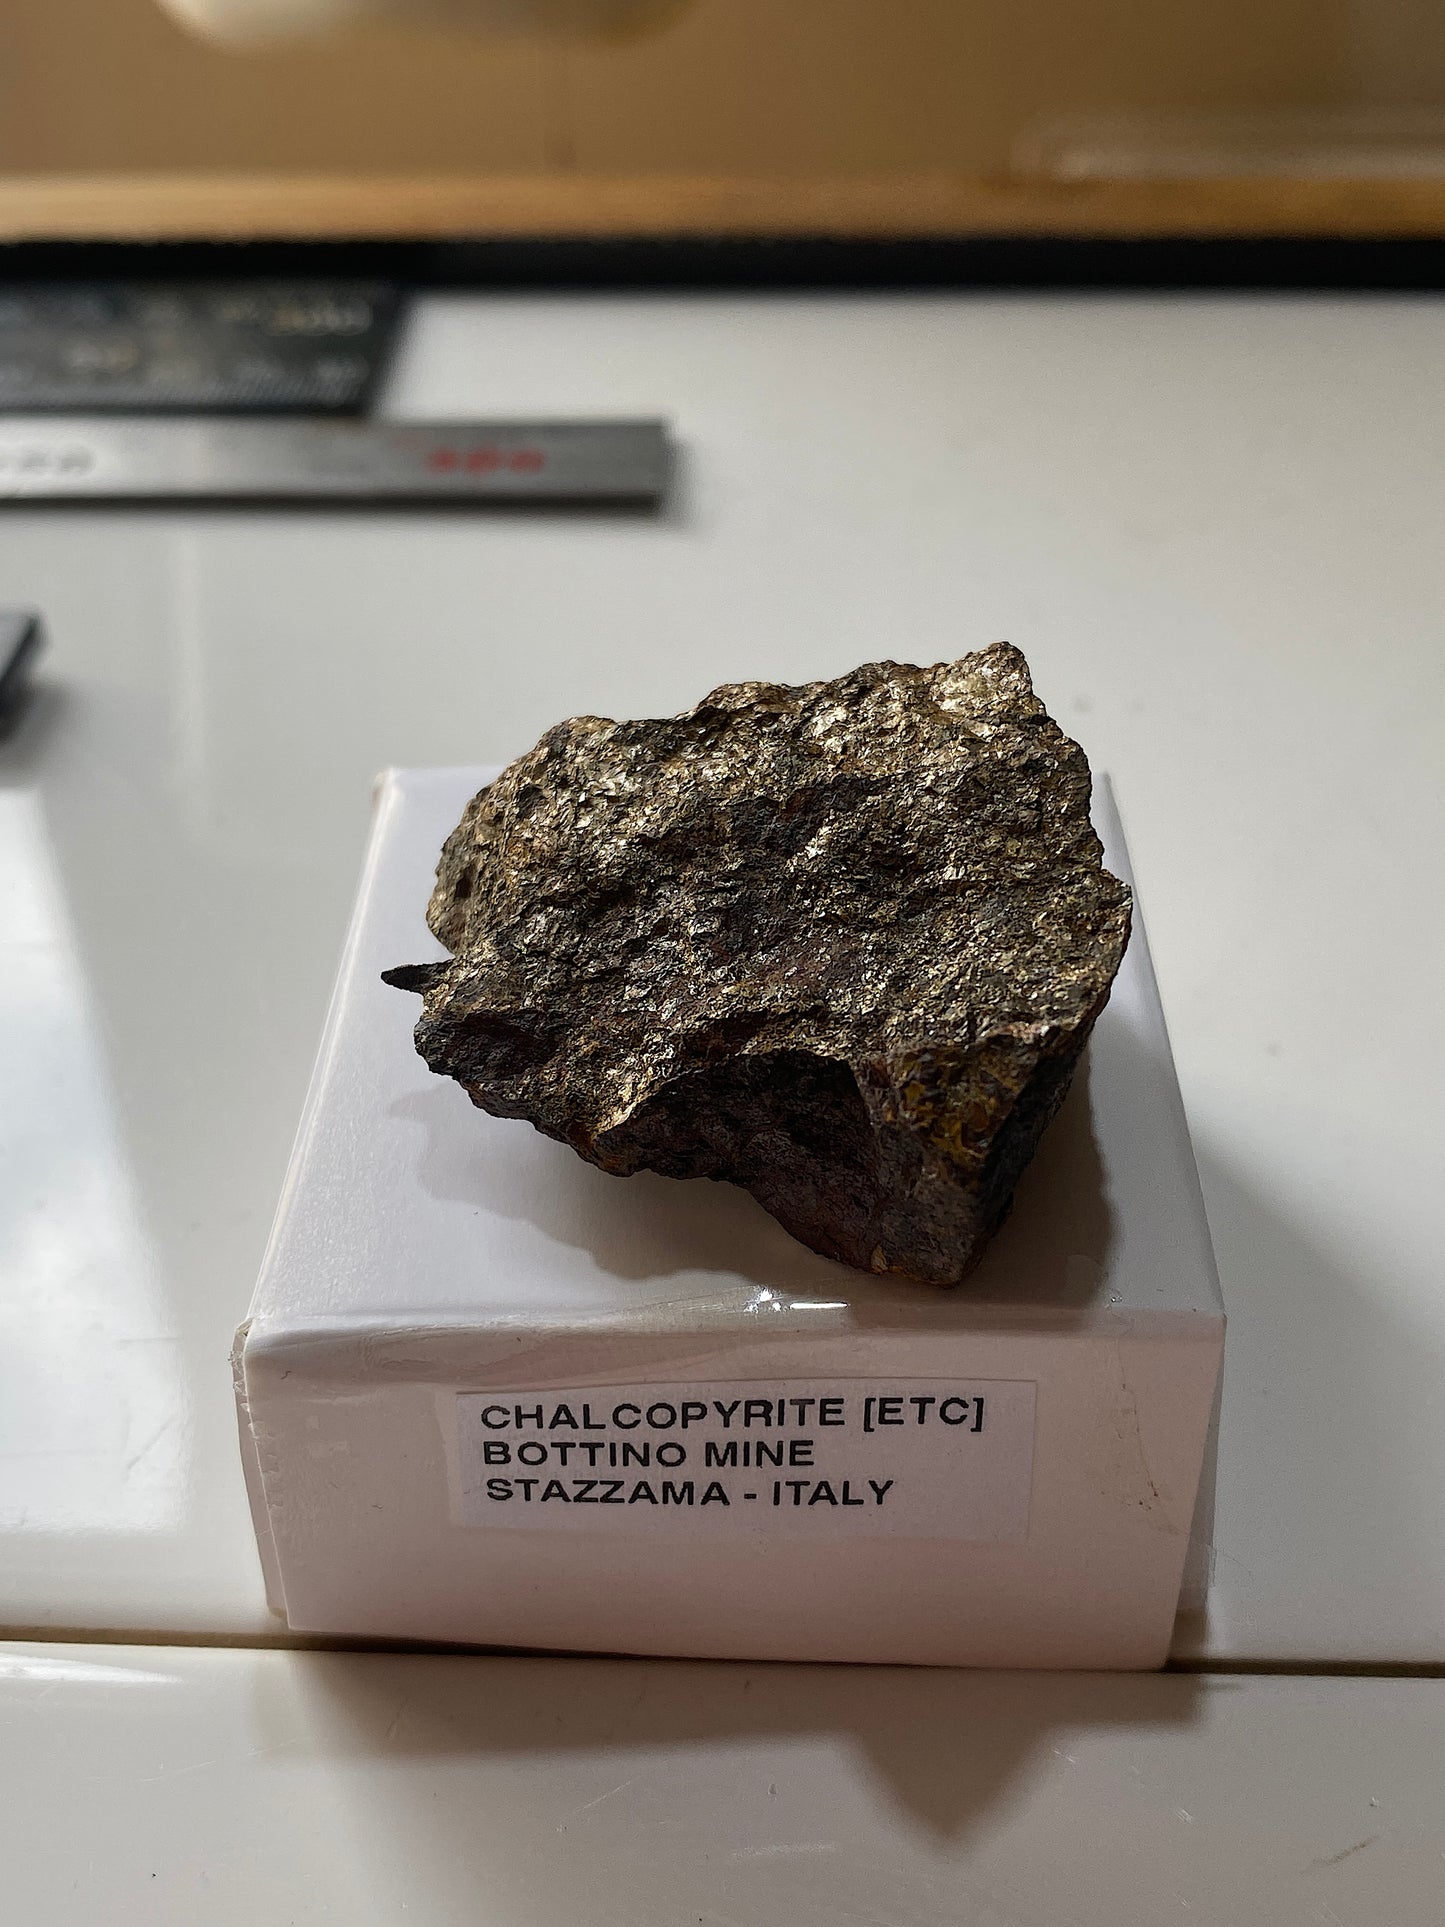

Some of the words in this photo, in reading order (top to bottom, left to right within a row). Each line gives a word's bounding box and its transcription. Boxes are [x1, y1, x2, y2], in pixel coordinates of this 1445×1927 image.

[481, 1397, 846, 1430] CHALCOPYRITE
[863, 1397, 985, 1433] [ETC]
[482, 1441, 687, 1467] BOTTINO
[704, 1440, 815, 1467] MINE
[486, 1478, 731, 1506] STAZZAMA
[773, 1480, 894, 1506] ITALY
